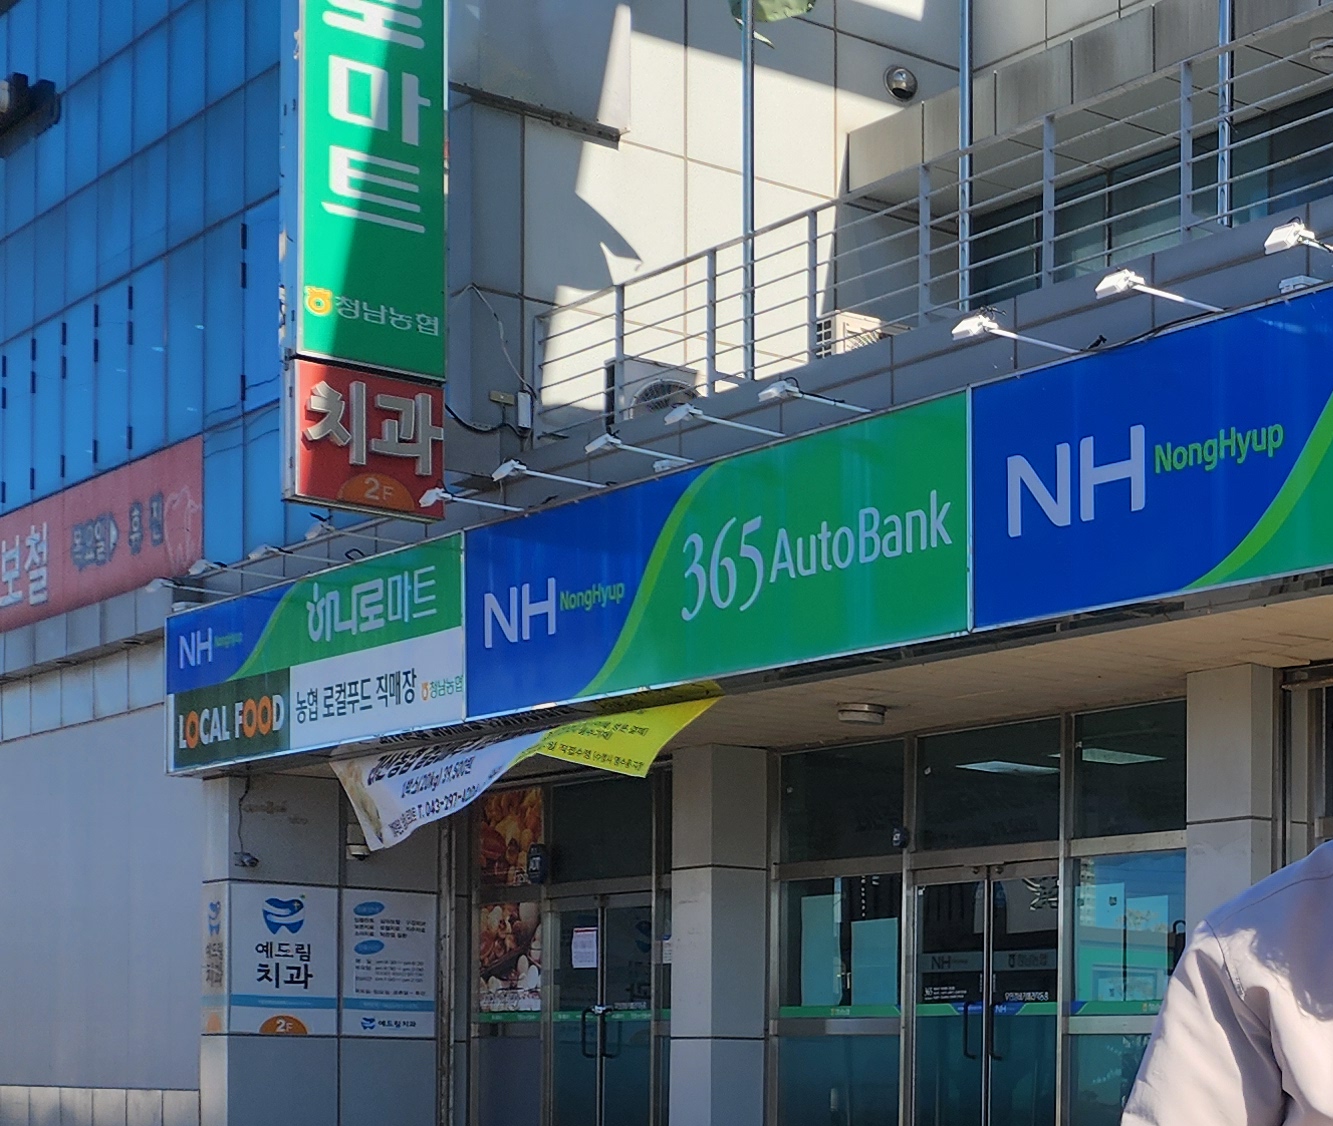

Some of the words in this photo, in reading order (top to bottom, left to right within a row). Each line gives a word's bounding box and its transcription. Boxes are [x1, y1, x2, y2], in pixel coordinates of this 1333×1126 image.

[336, 295, 439, 337] 청남농협
[302, 380, 444, 476] 치과
[364, 477, 394, 500] 2F
[1007, 423, 1146, 538] NH
[1153, 420, 1284, 474] NongHyup
[305, 565, 437, 642] 하나로마트
[483, 577, 556, 649] NH
[559, 581, 625, 612] NongHyup
[179, 627, 213, 669] NH
[295, 687, 318, 724] 농협
[322, 678, 372, 719] 로컬푸드
[375, 668, 417, 708] 직매장
[178, 704, 230, 749] LOCAL
[234, 694, 285, 741] FOOD
[255, 942, 312, 963] 예드림
[256, 962, 314, 990] 치과
[275, 1018, 293, 1033] 2F
